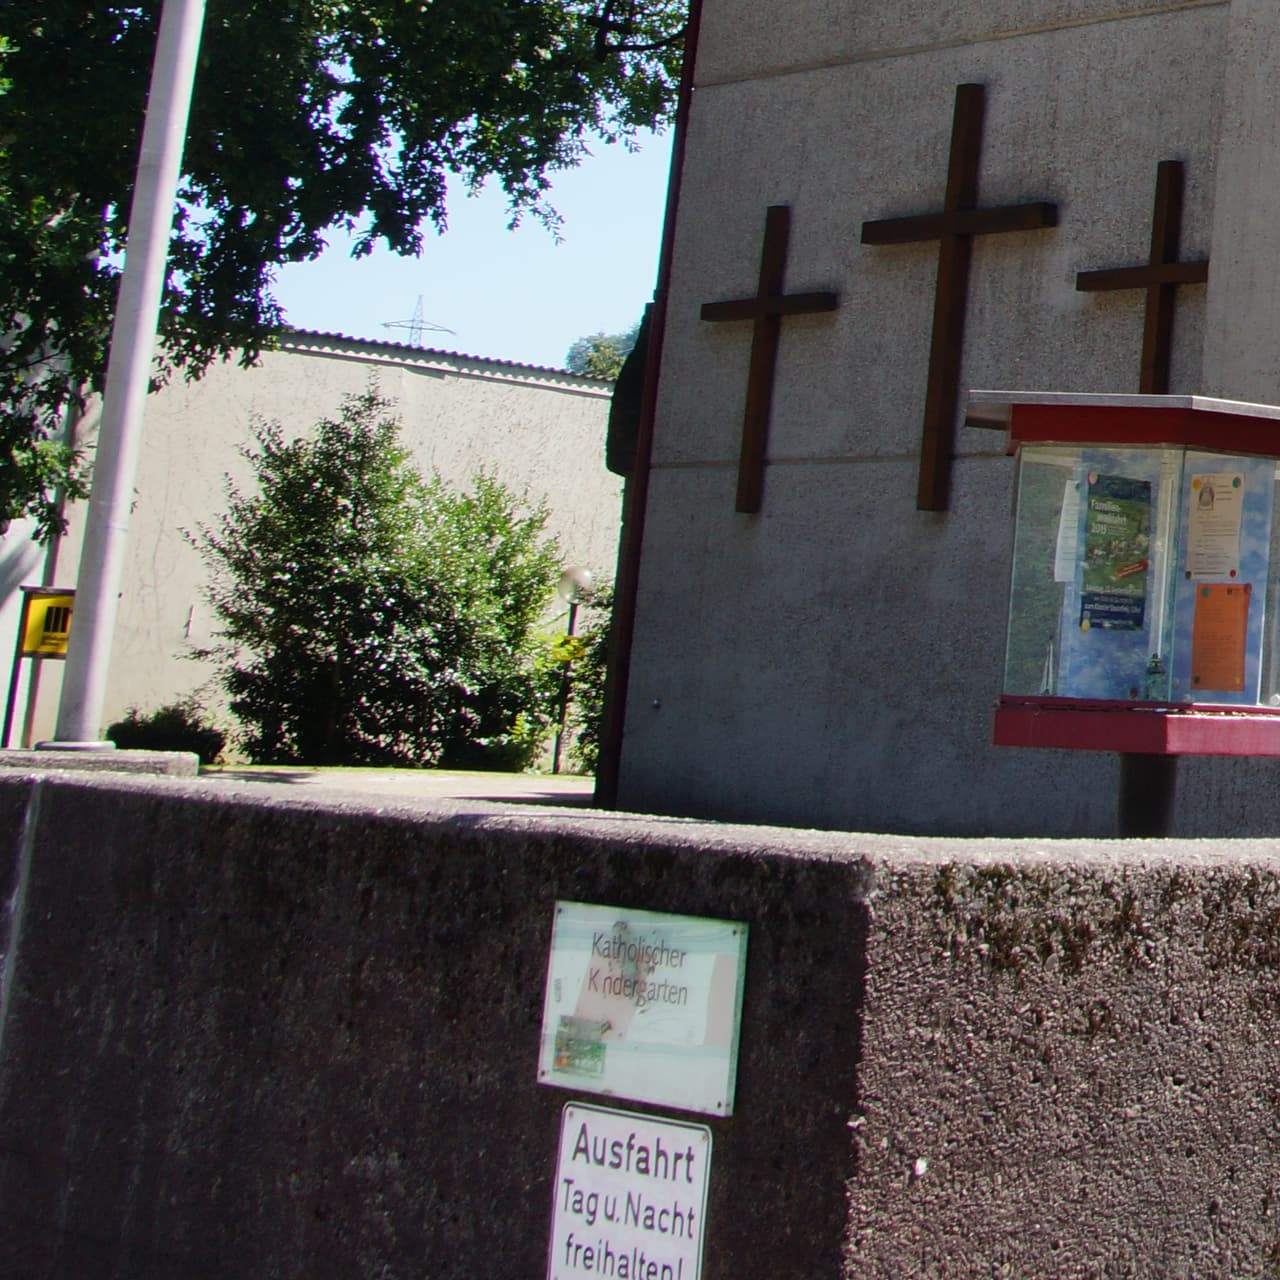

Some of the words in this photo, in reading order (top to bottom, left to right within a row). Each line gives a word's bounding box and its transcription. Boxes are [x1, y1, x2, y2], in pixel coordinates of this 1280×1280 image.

[592, 932, 687, 968] Katholischer
[588, 968, 688, 1007] Kndergarten
[572, 1122, 695, 1184] Ausfahrt
[564, 1177, 599, 1226] Tag
